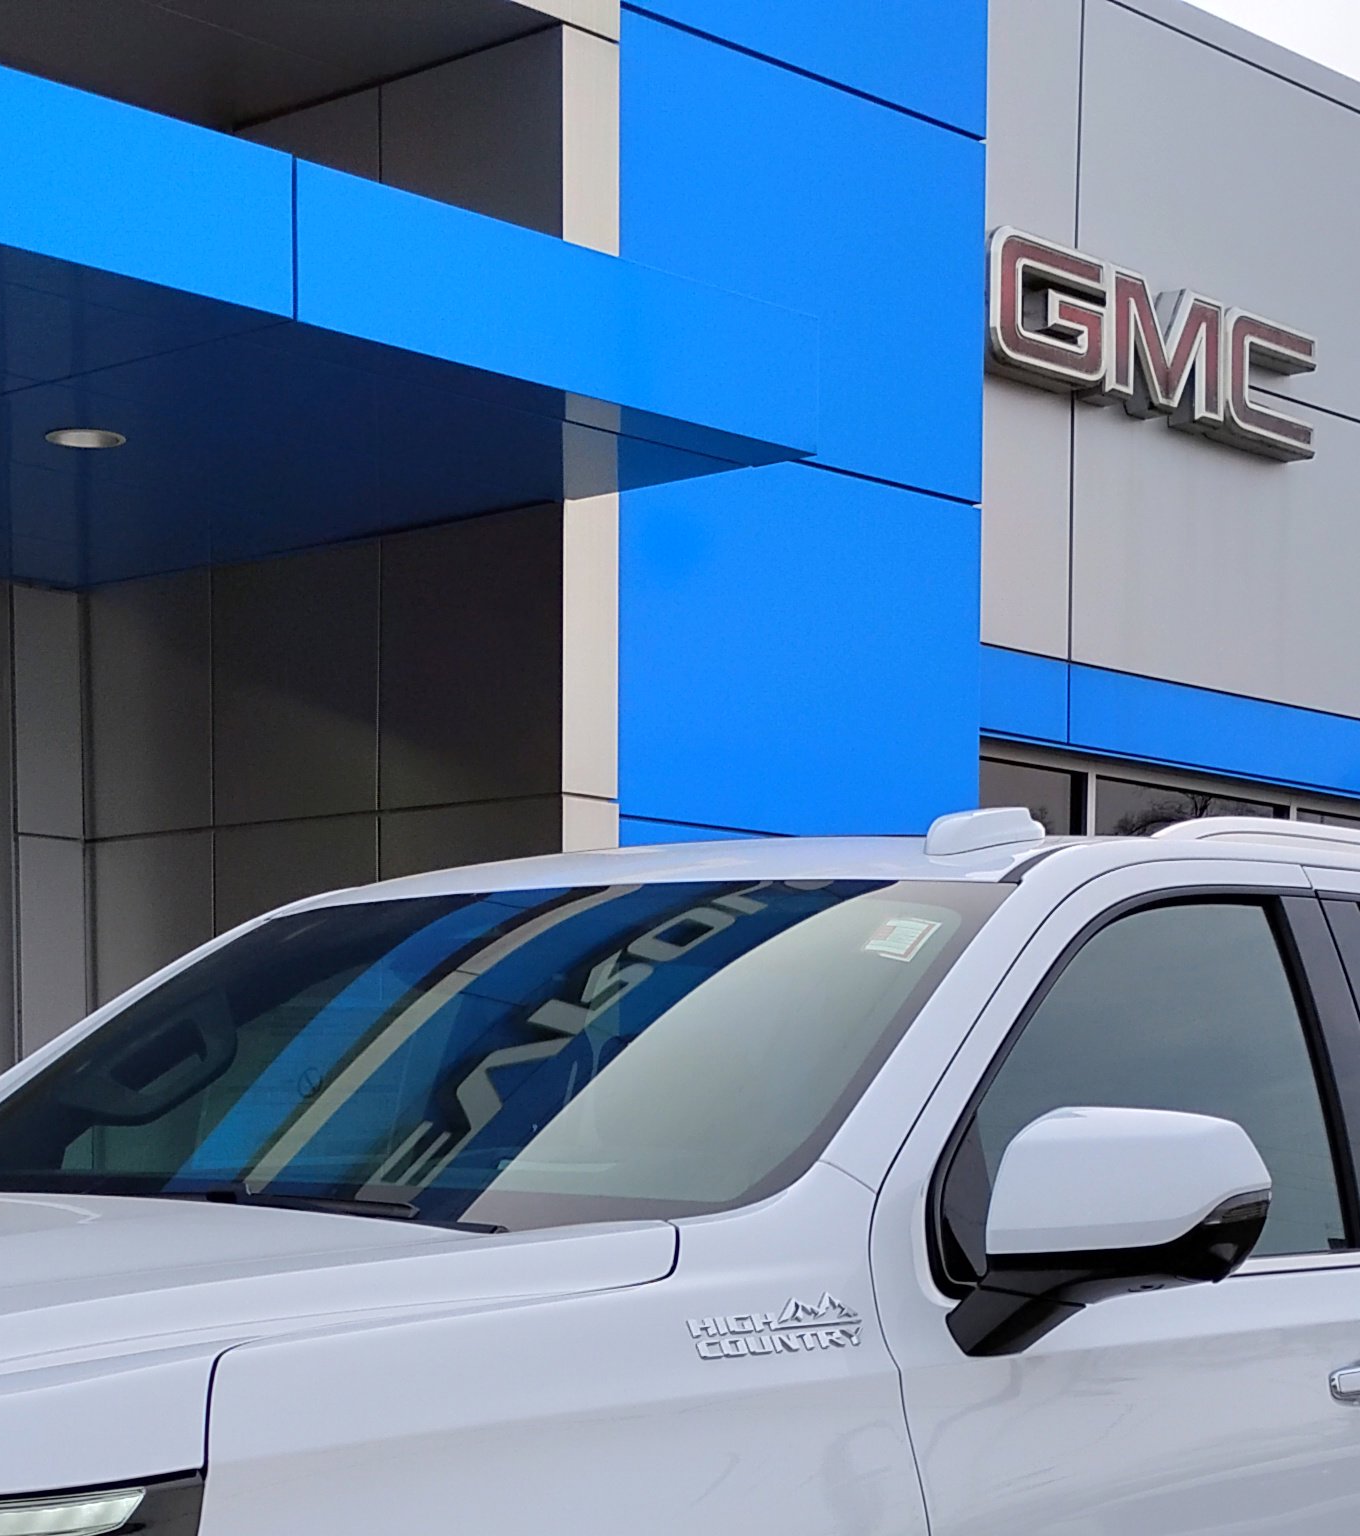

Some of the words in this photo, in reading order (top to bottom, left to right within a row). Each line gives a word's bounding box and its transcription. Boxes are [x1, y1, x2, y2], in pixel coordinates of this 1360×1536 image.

[986, 224, 1317, 462] GMC
[686, 1311, 779, 1339] HIGH
[695, 1326, 863, 1361] COUNTRY
